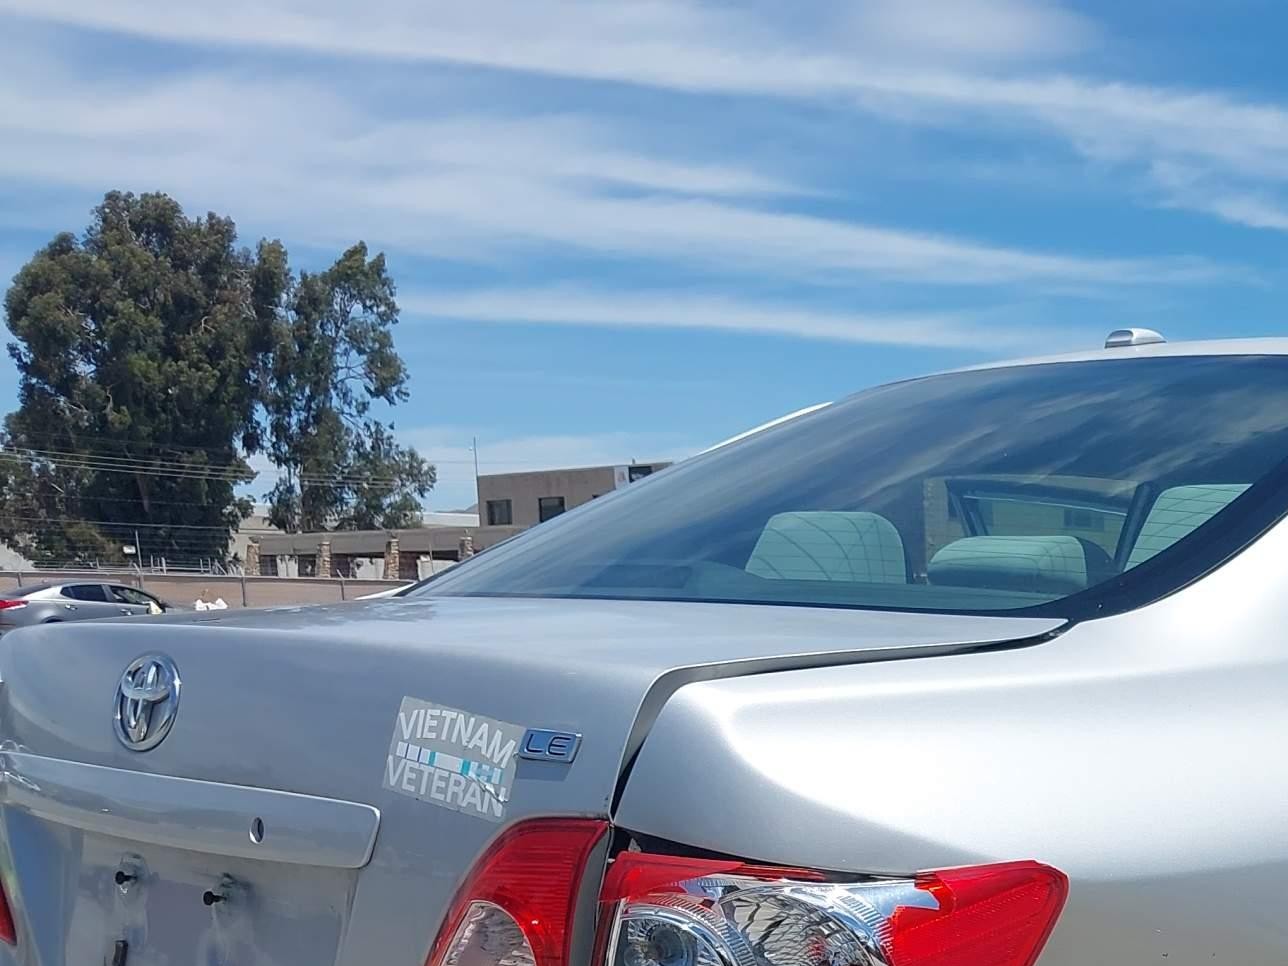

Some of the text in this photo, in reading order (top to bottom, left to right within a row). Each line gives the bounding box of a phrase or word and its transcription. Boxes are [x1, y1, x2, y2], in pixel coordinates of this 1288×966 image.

[399, 709, 516, 769] VIETNAM
[523, 733, 572, 756] LE
[386, 755, 507, 817] VETERAN
